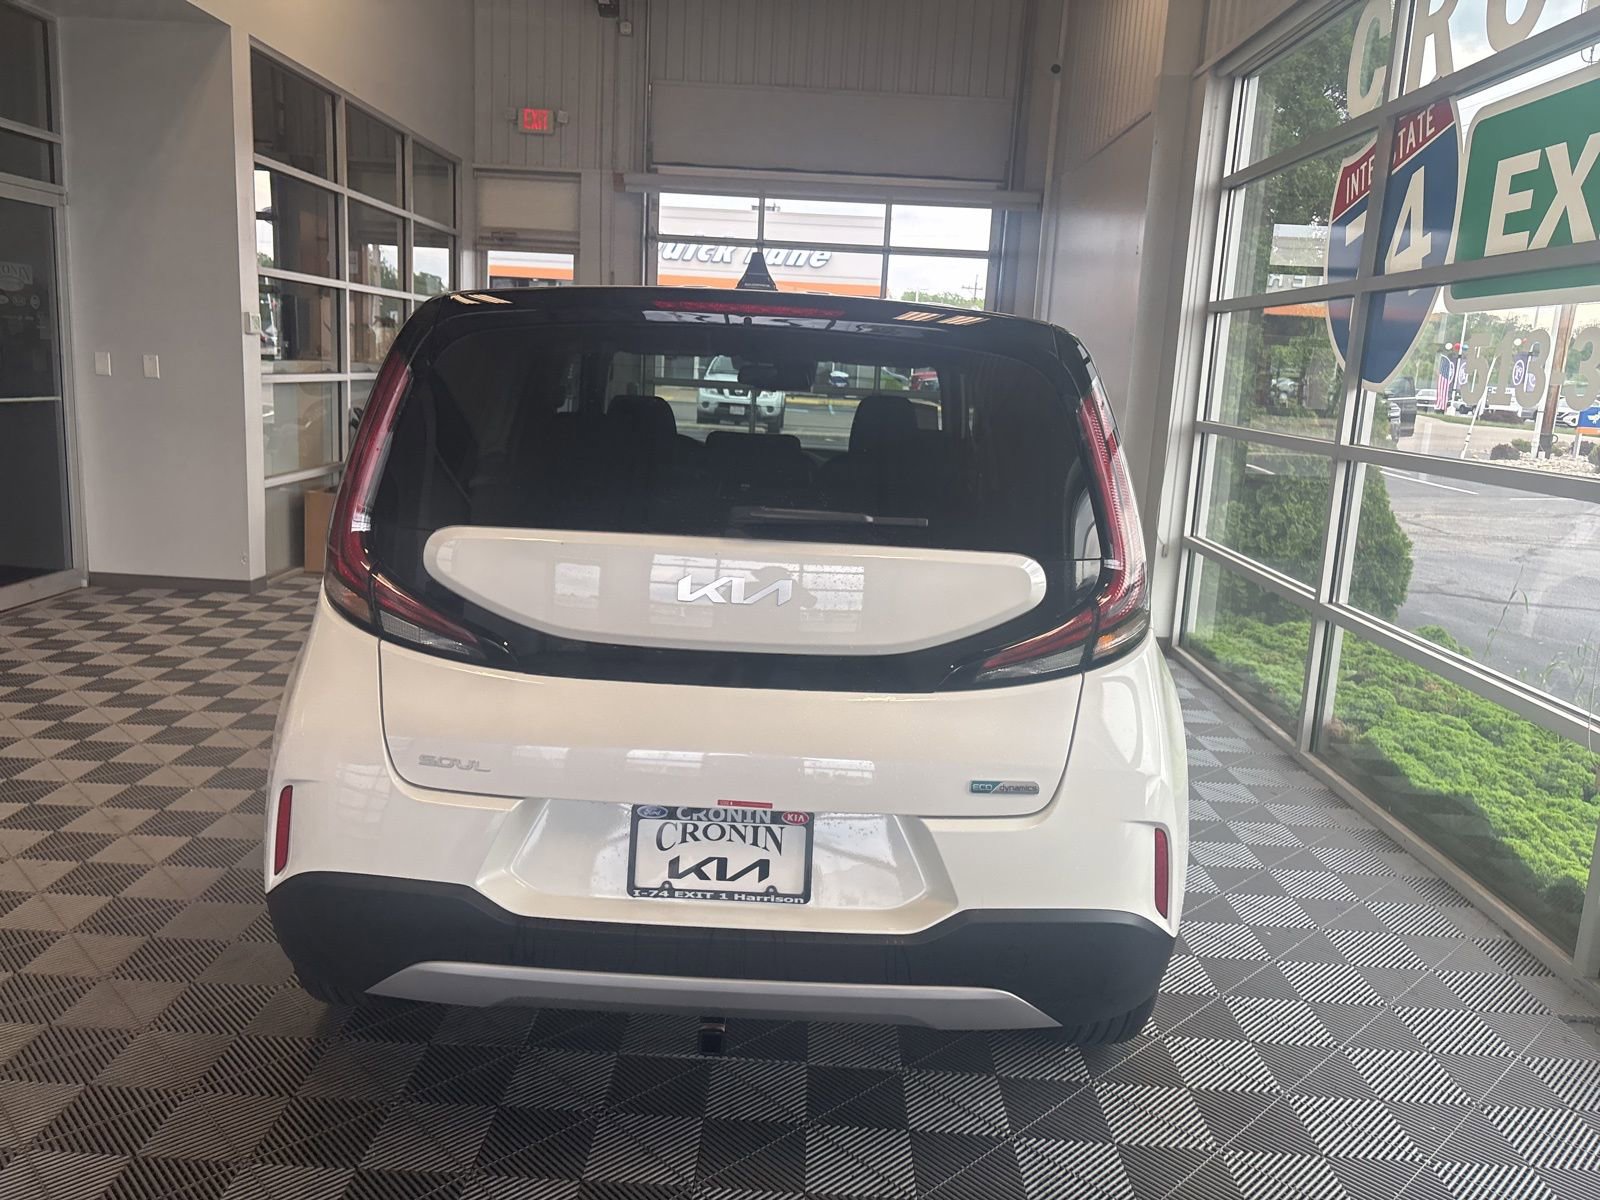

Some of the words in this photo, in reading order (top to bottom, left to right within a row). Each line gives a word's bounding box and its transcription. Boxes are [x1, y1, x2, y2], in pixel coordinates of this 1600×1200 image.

[523, 108, 548, 130] EXIT
[1345, 103, 1436, 204] INTETATE
[677, 574, 793, 607] KIA
[418, 754, 491, 773] SOUL
[999, 783, 1037, 792] dynamics
[676, 806, 771, 824] CRONIN
[787, 813, 804, 822] KIA
[655, 821, 785, 856] CRONIN
[667, 855, 770, 883] KIA
[632, 889, 669, 898] I-74
[674, 890, 713, 900] EXIT
[719, 892, 728, 900] 1
[734, 893, 804, 904] Harrison
